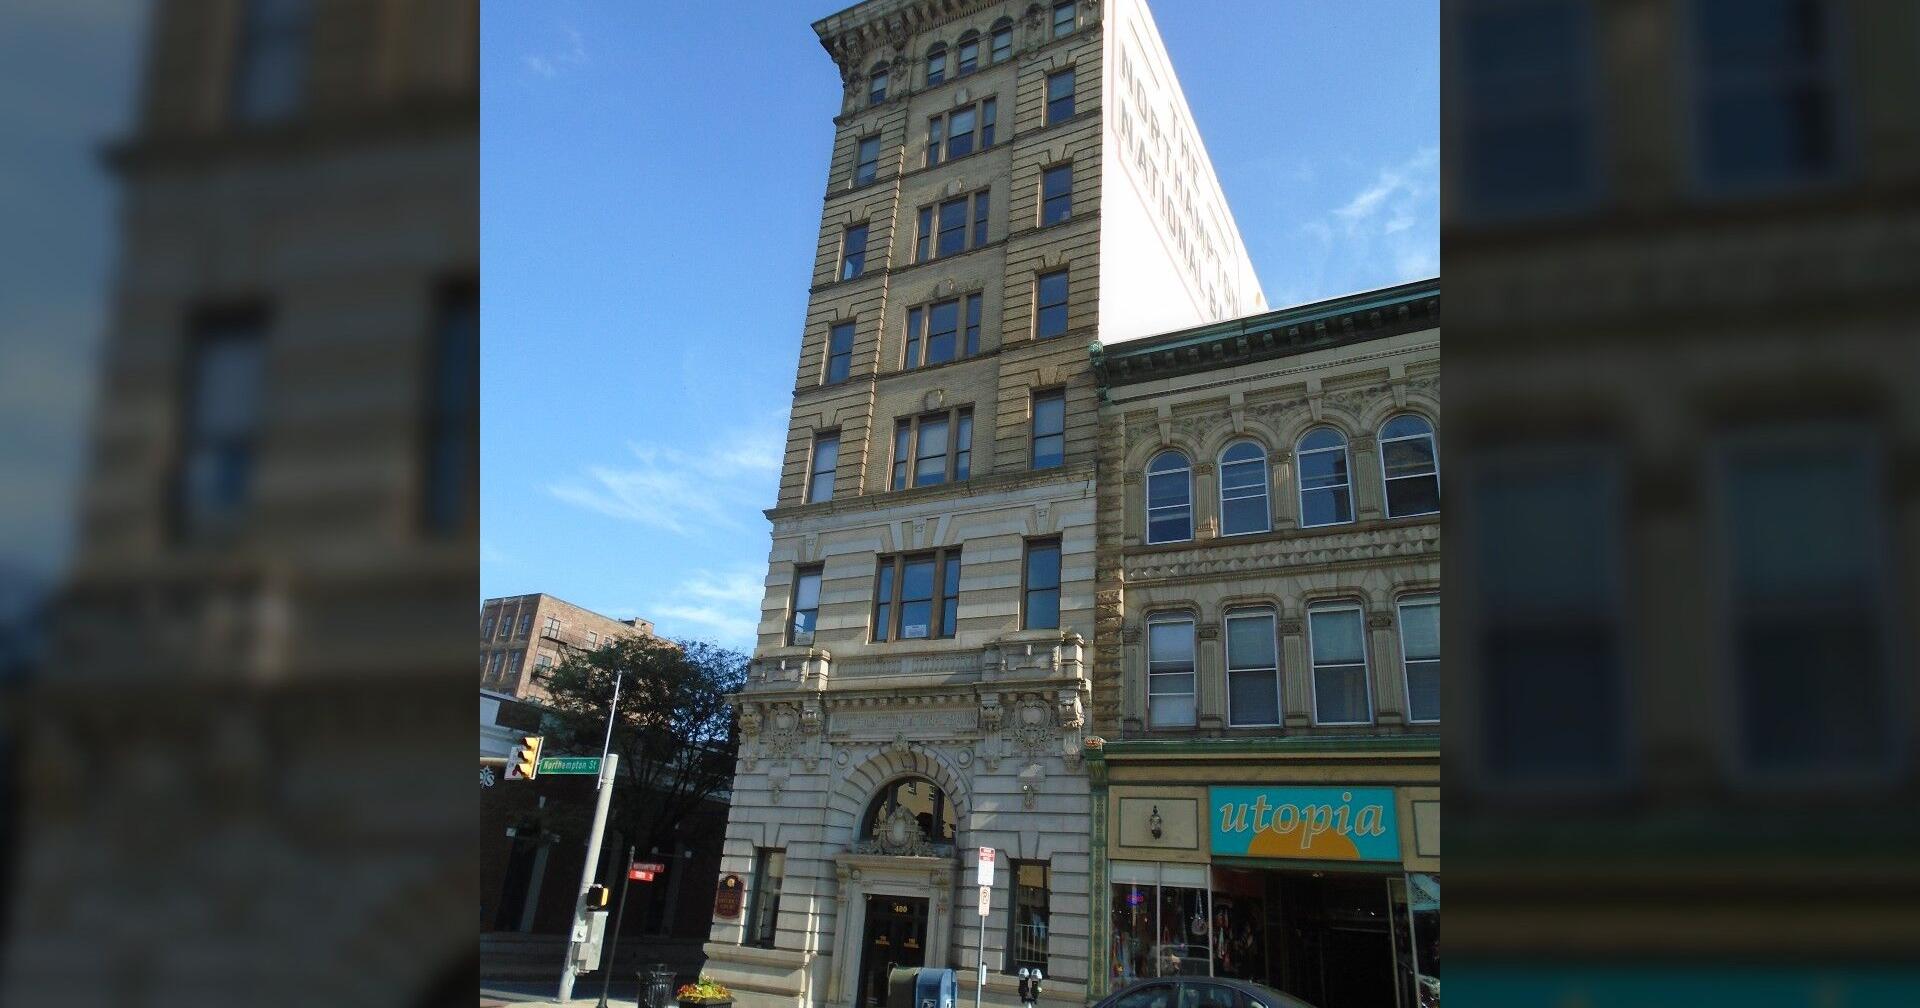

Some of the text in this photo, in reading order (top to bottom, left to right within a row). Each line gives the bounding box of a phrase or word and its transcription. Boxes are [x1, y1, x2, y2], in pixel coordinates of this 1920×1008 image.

[1120, 42, 1239, 317] NORTHAMPTON
[1168, 100, 1200, 195] THE
[1120, 96, 1207, 298] NATIONAL
[588, 759, 598, 770] St
[1218, 791, 1387, 850] utopia
